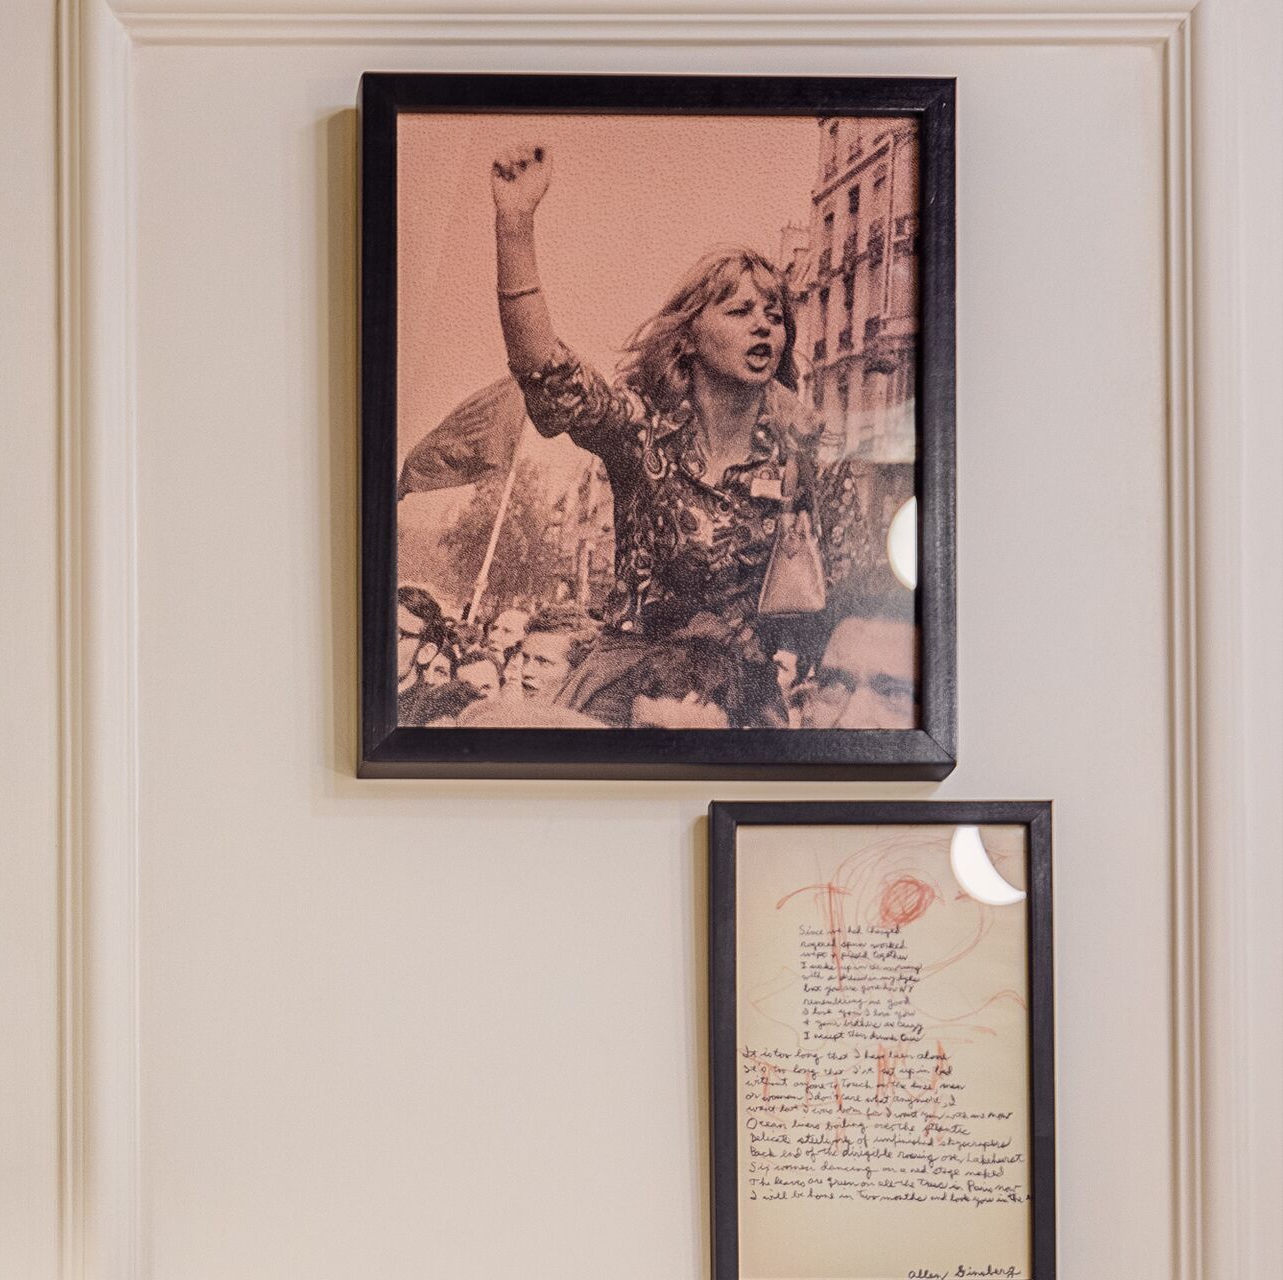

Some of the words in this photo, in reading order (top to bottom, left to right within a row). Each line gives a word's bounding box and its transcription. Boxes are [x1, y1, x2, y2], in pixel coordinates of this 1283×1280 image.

[794, 1048, 825, 1066] long
[916, 1050, 951, 1060] alone
[793, 1064, 819, 1081] long
[746, 1117, 789, 1130] Ocean
[749, 1145, 776, 1158] Back
[780, 1147, 802, 1159] end
[748, 1177, 771, 1187] The
[762, 1188, 789, 1201] will
[807, 1187, 835, 1200] home
[838, 1193, 855, 1201] in
[955, 1264, 1022, 1279] Ginsberg
